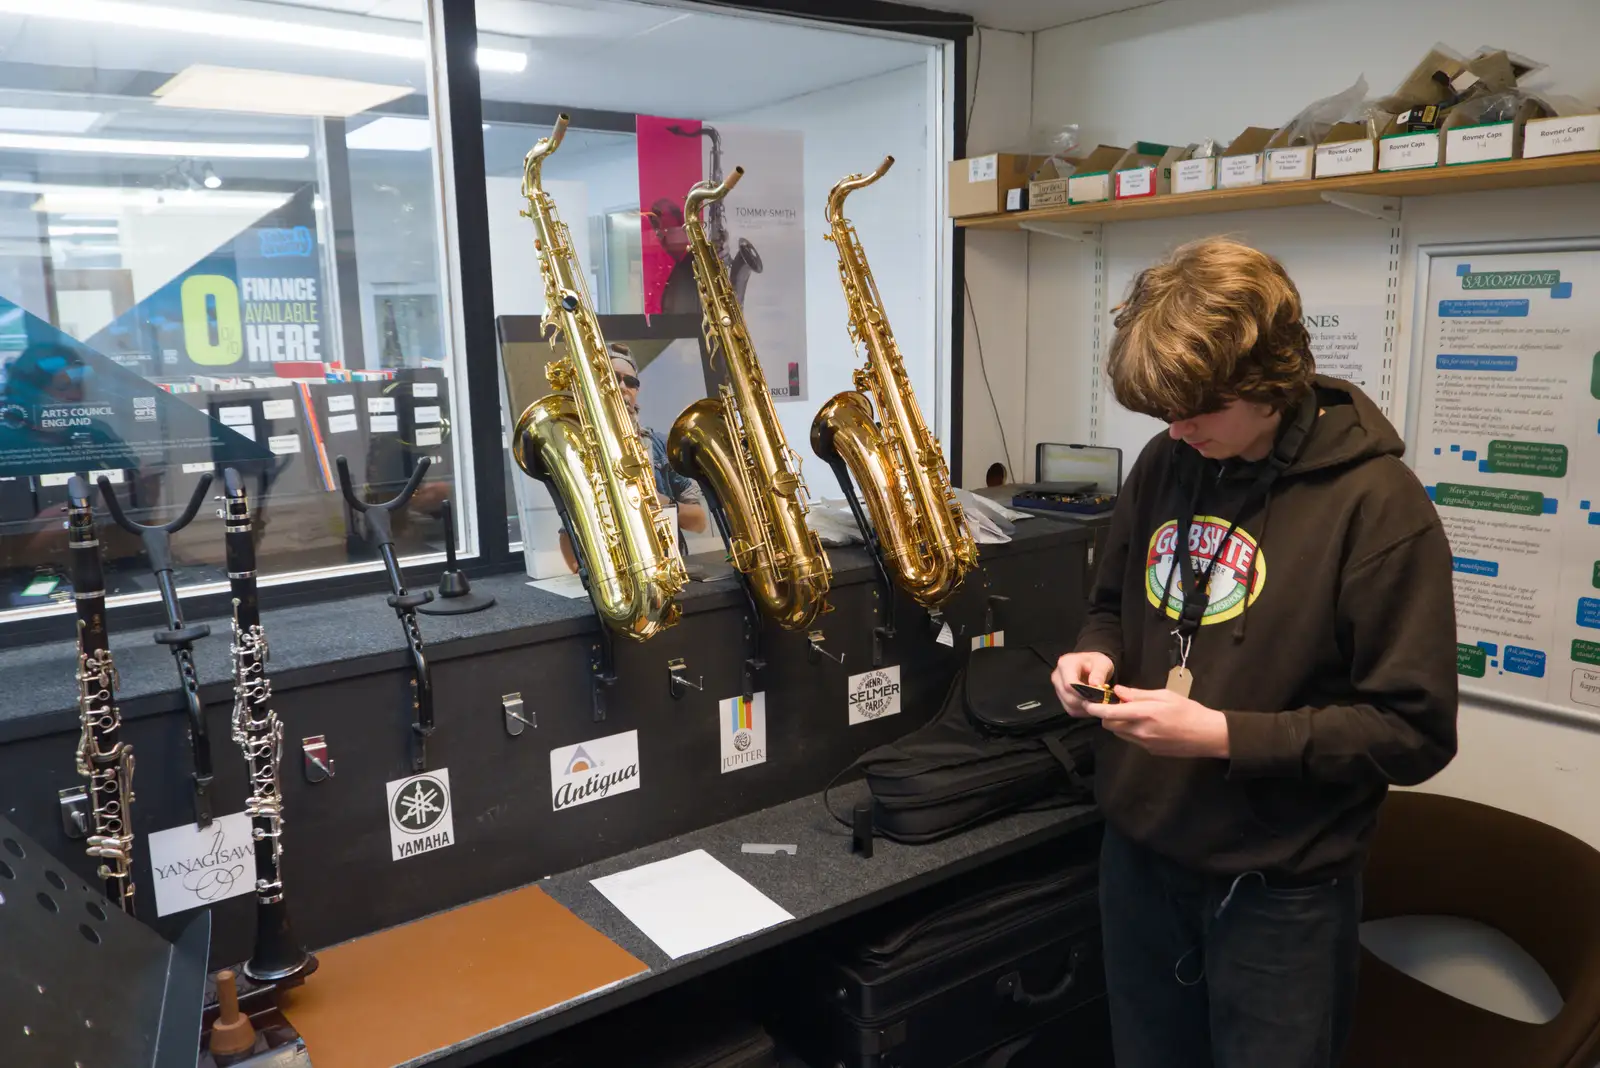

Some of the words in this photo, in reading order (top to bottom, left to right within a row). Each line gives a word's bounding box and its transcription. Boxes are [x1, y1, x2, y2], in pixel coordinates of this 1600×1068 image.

[1487, 131, 1502, 140] Caps
[1541, 128, 1565, 136] Rovner
[1567, 126, 1585, 134] Caps
[736, 207, 767, 217] TOMMY
[769, 208, 796, 218] SMITH
[1462, 273, 1556, 288] SAXOPHONE
[242, 278, 317, 301] FINANCE
[245, 302, 319, 323] AVAILABLE
[1320, 332, 1335, 340] have
[1342, 332, 1358, 340] wide
[246, 324, 321, 362] HERE
[41, 408, 68, 418] ARTS
[71, 406, 114, 417] COUNCIL
[42, 417, 92, 428] ENGLAND
[1448, 486, 1467, 495] Have
[1467, 489, 1480, 498] you
[1481, 489, 1508, 500] thought
[1509, 492, 1530, 501] about
[1442, 496, 1475, 507] upgrading
[1476, 499, 1492, 508] your
[1492, 500, 1536, 512] mouthpiece?
[1507, 647, 1519, 655] Ask
[1519, 649, 1535, 658] about
[1510, 656, 1540, 666] mouthpiece
[865, 677, 883, 689] HENRI
[1583, 672, 1598, 681] Our
[849, 684, 900, 705] SELMER
[865, 699, 883, 711] PARIS
[723, 749, 763, 771] JUPITER
[554, 762, 638, 810] Antigua
[397, 831, 450, 857] YAMAHA
[155, 842, 256, 880] YANAGISAW
